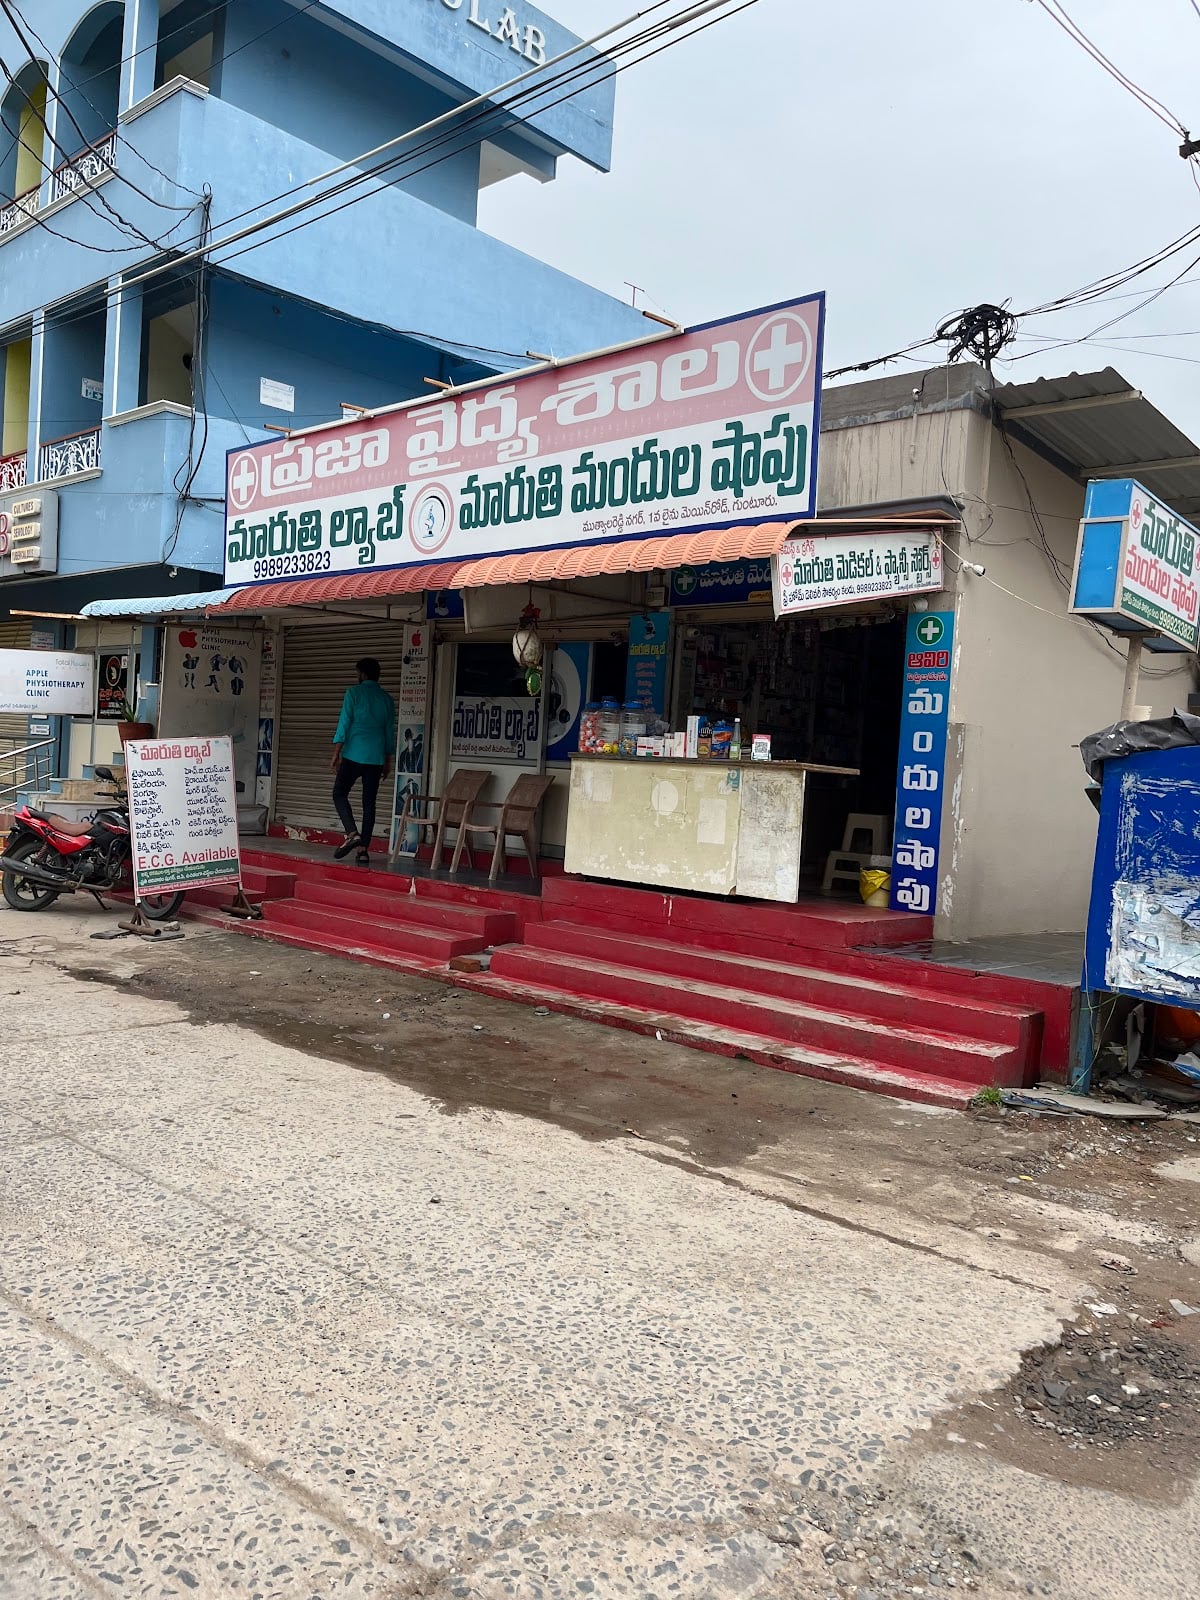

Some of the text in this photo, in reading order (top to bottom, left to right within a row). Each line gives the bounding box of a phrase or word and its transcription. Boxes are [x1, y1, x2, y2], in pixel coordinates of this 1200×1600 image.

[259, 339, 741, 498] ప్రజా వైద్య శాల
[228, 413, 810, 566] మారుతి ల్యాబ్ మారుతి మందుల షాపు
[1141, 501, 1195, 577] మారుతి
[253, 552, 331, 580] 9989233823
[700, 567, 745, 587] మారుతి
[794, 556, 834, 585] మారుతి
[836, 549, 874, 580] మెడికల్
[857, 581, 892, 594] 9989233823
[1124, 544, 1198, 622] మందుల షాపు
[1159, 609, 1195, 641] 9989233823
[26, 669, 48, 677] APPLE
[26, 679, 85, 688] PHYSIOTHERAPY
[26, 689, 50, 697] CLINIC
[453, 698, 541, 758] మారుతి ల్యాబ్
[140, 741, 211, 764] మారుతి ల్యాబ్
[138, 846, 237, 869] E.C.G. Available
